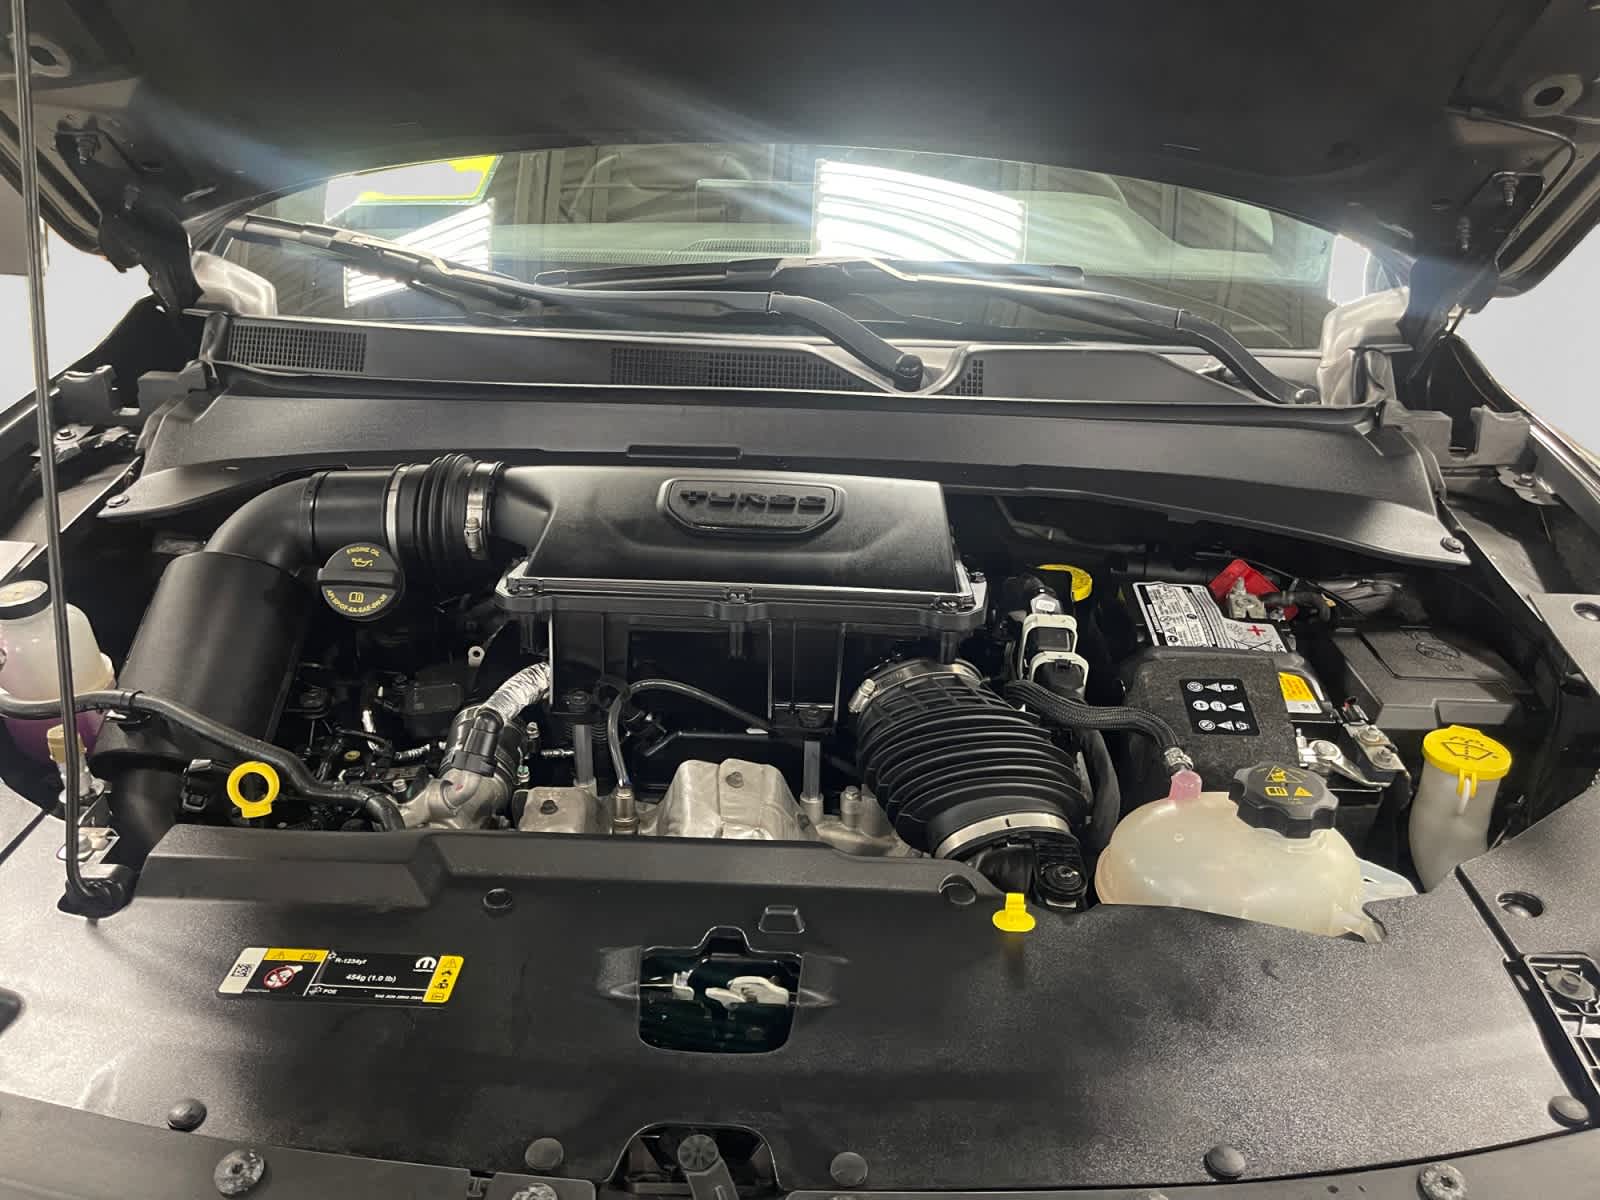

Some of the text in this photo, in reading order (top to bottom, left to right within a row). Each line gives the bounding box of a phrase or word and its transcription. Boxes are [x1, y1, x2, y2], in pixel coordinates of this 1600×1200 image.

[346, 546, 370, 555] ENGINE
[345, 973, 366, 982] 454g
[367, 974, 385, 982] (1.0
